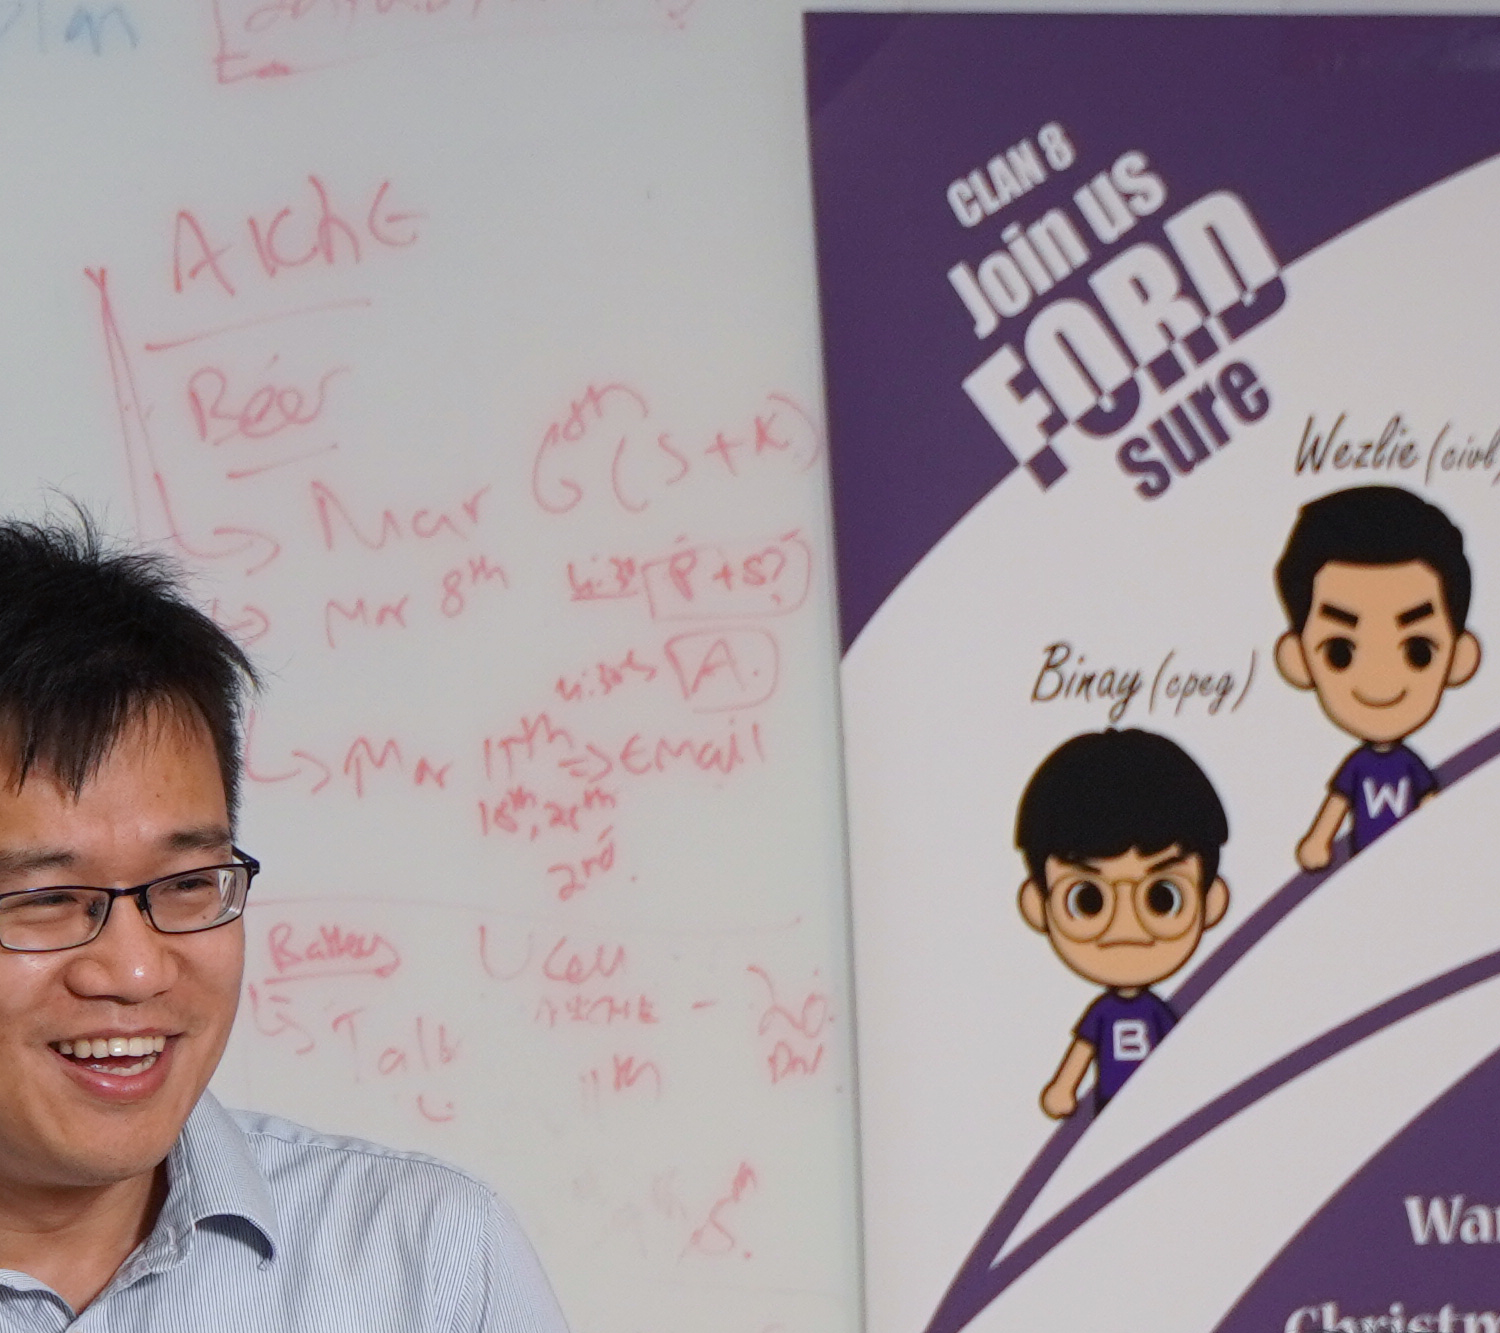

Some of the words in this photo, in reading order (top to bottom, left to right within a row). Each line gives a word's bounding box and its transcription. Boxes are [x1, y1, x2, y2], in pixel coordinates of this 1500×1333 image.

[946, 138, 1047, 229] CLAN
[1036, 120, 1076, 172] 8
[1115, 359, 1270, 502] sure
[1031, 641, 1144, 722] Binay
[1362, 776, 1410, 821] W
[1112, 1020, 1150, 1061] B
